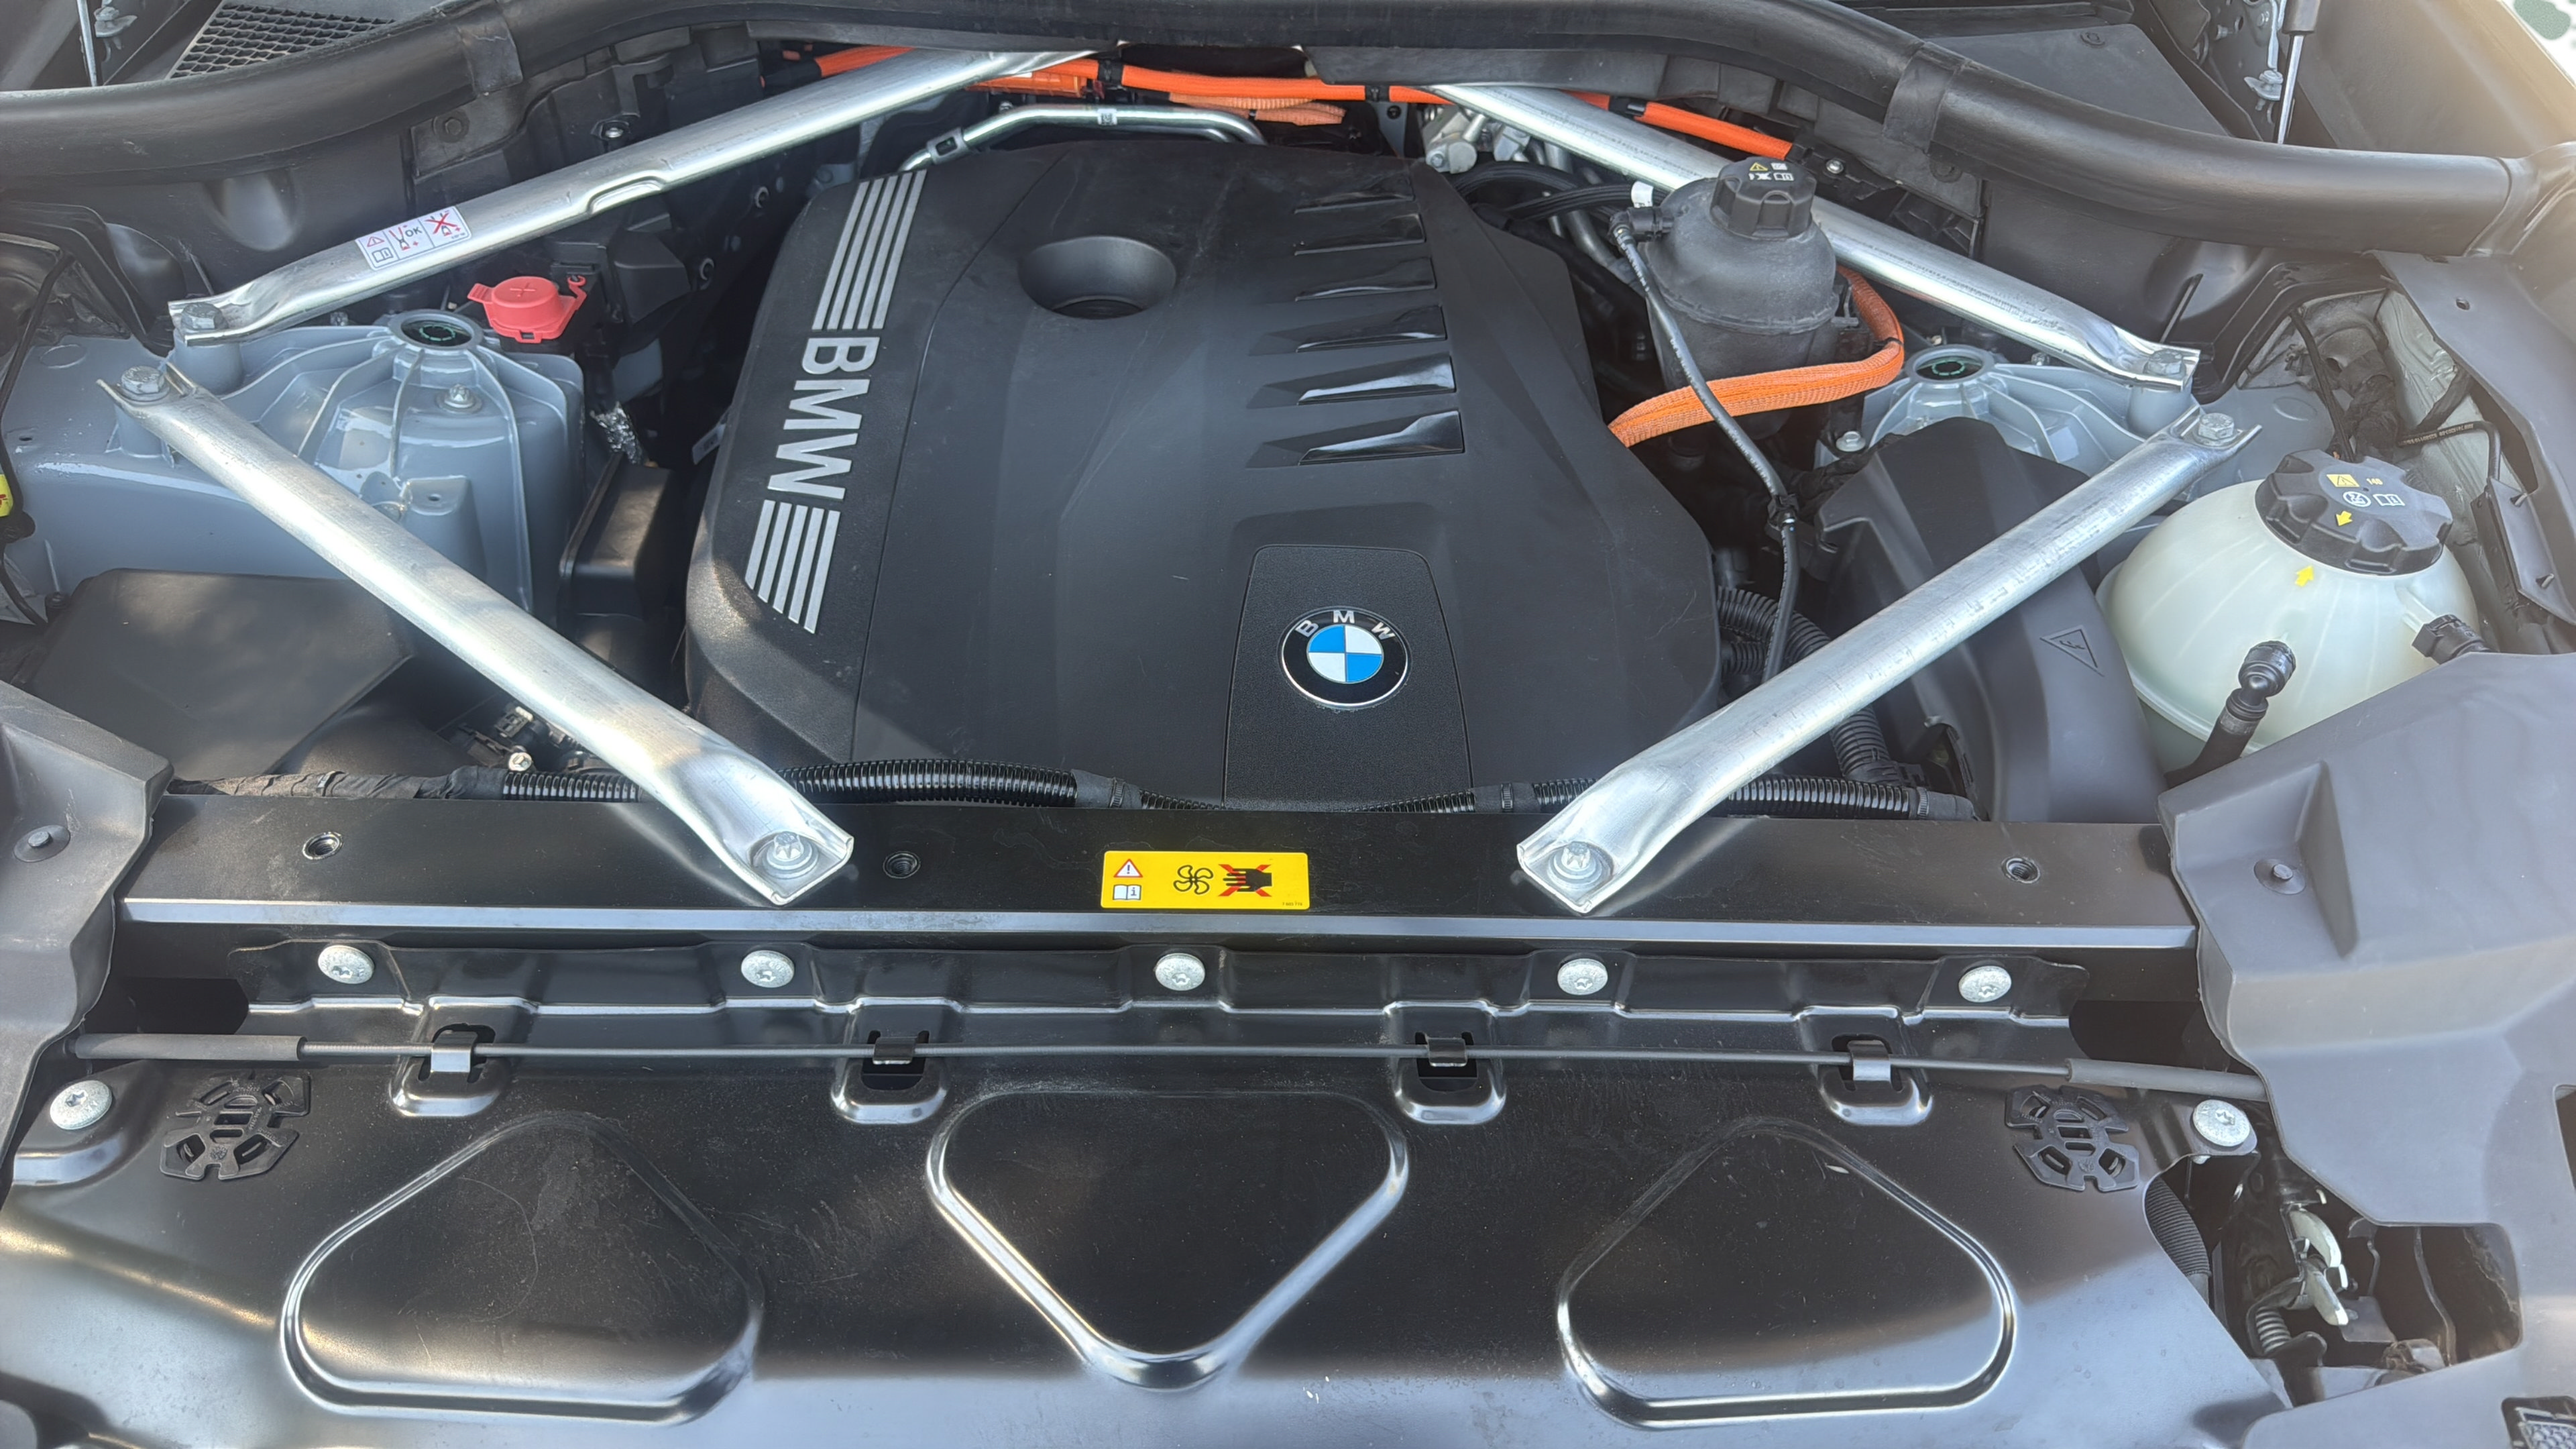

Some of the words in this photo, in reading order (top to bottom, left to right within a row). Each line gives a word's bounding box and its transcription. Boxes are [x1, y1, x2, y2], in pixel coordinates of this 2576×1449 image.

[404, 226, 423, 237] OK
[767, 337, 881, 500] BMW
[1294, 610, 1396, 640] BMW
